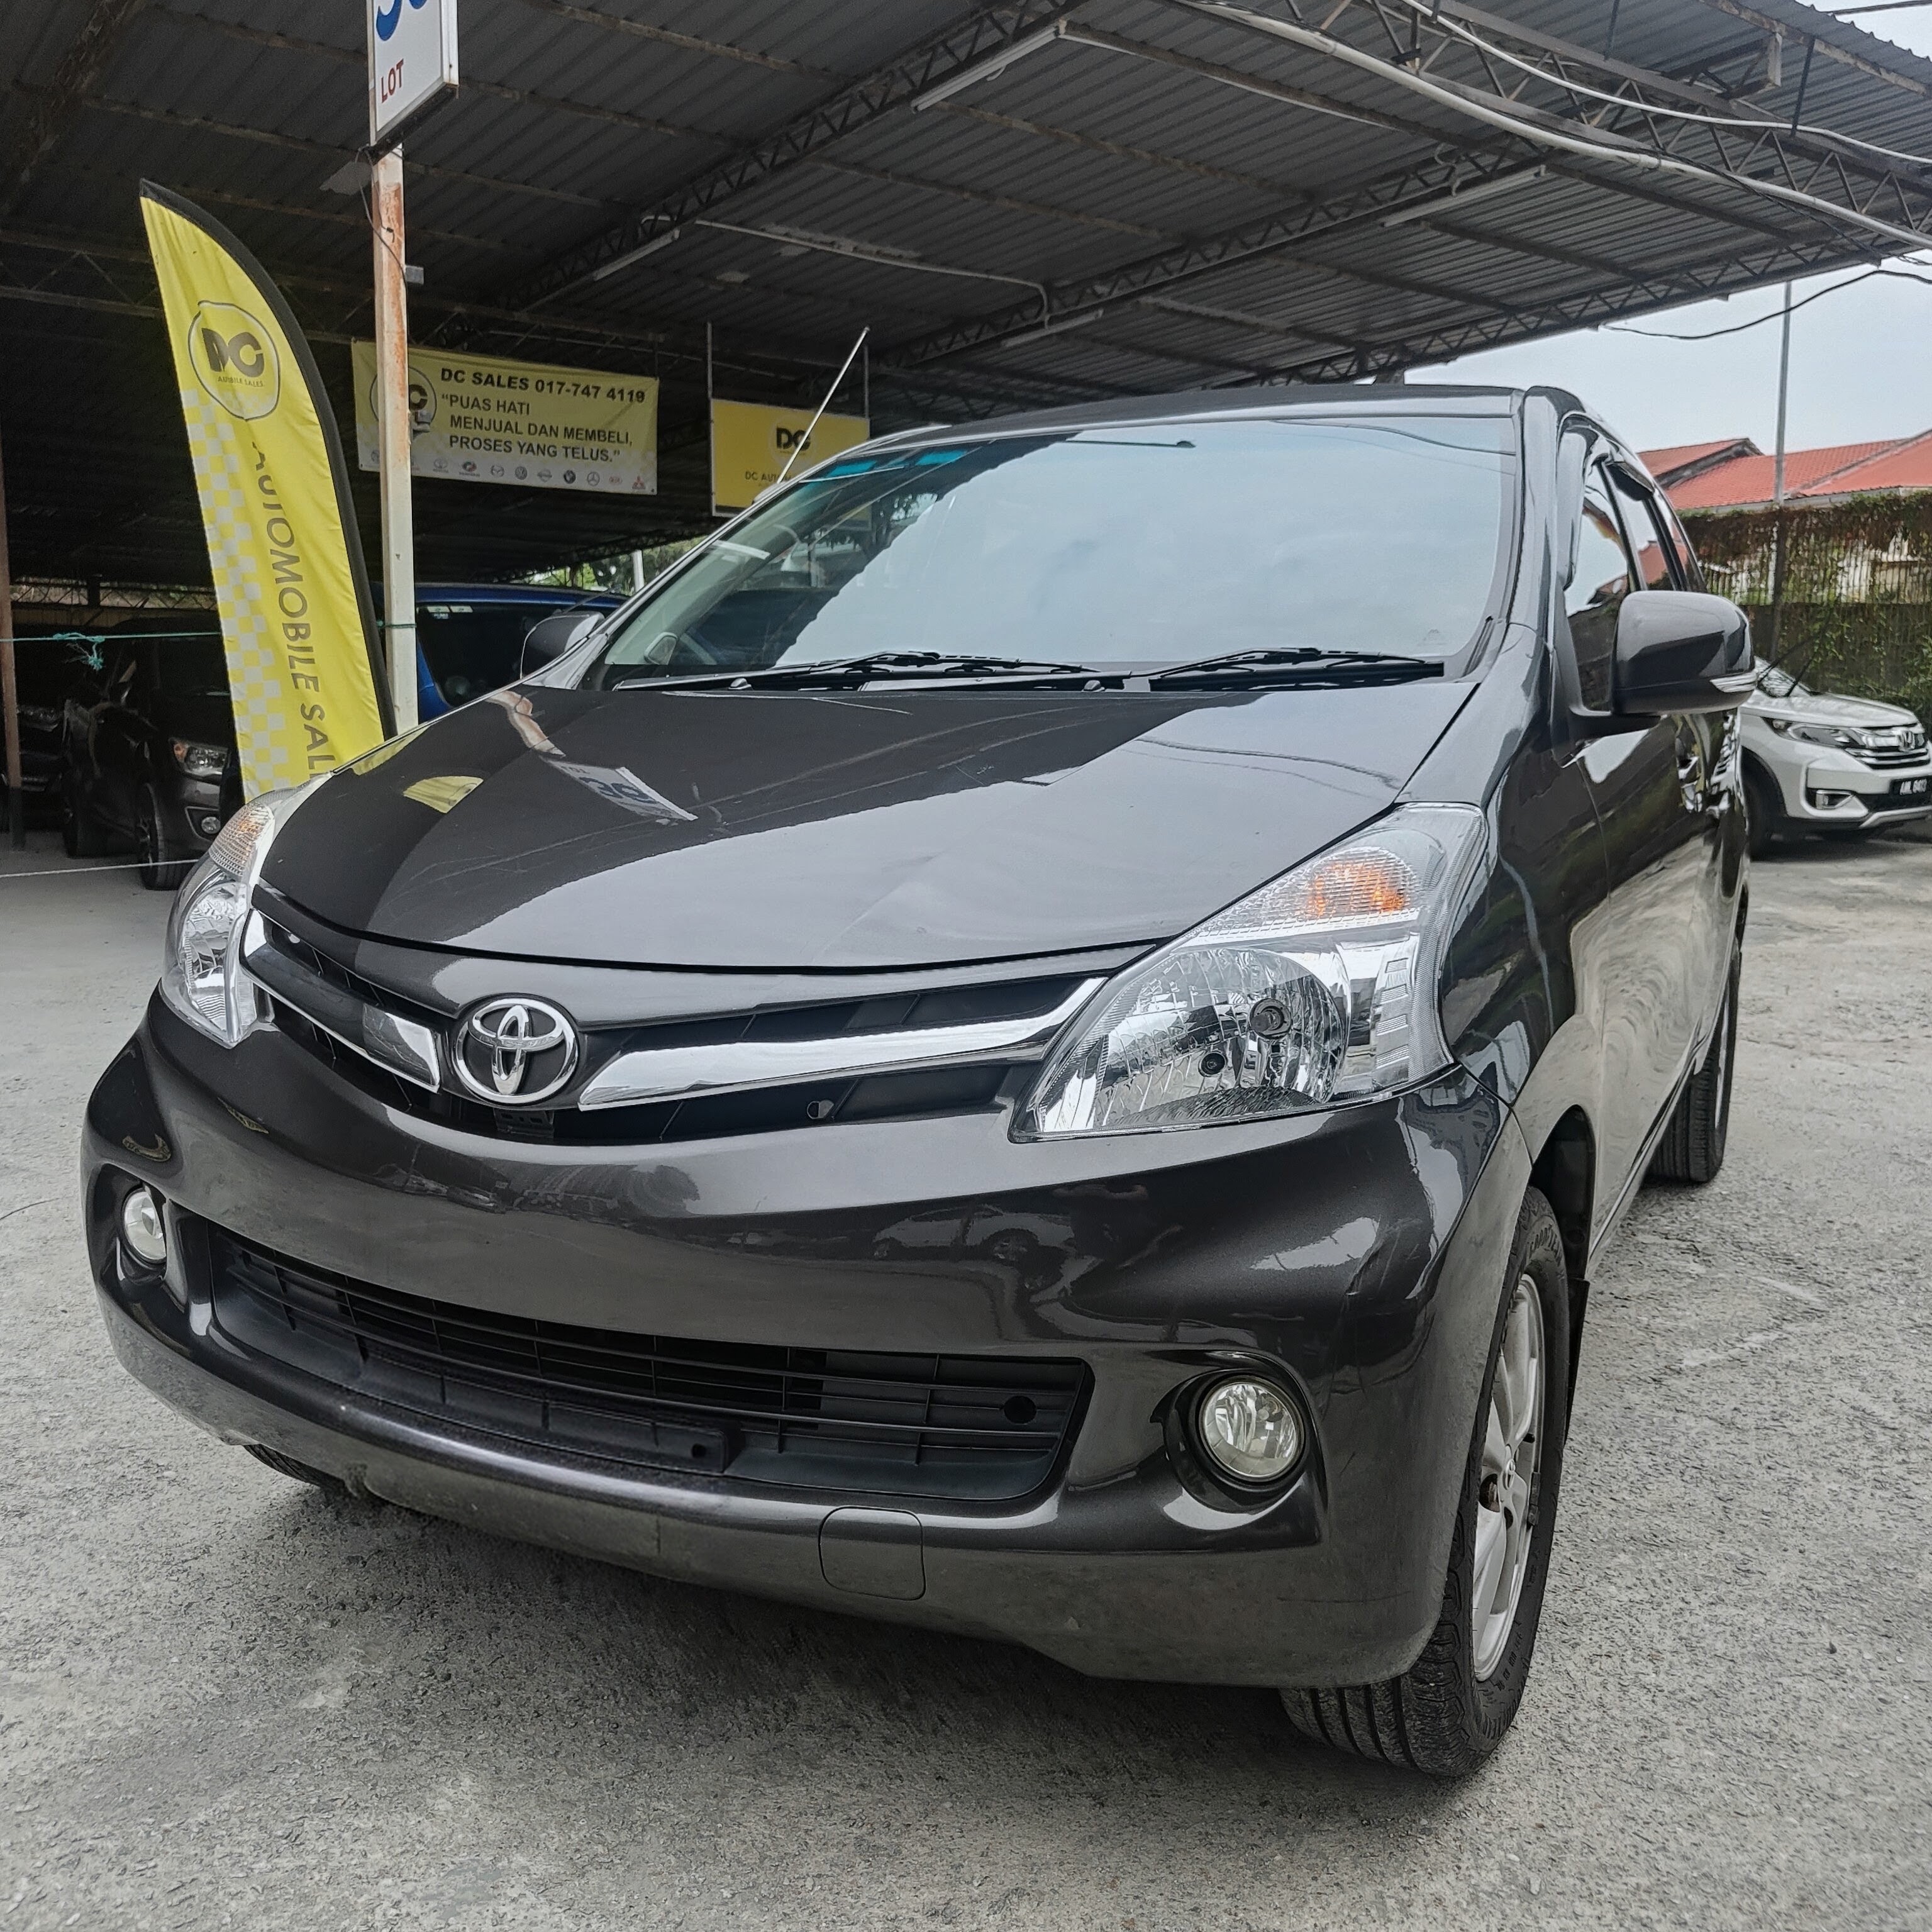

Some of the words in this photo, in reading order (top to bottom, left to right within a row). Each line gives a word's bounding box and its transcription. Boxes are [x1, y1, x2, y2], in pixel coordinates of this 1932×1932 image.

[381, 58, 404, 103] LOT
[441, 367, 465, 384] DC
[472, 372, 530, 391] SALES
[535, 379, 601, 399] 017-747
[606, 387, 645, 403] 4119
[441, 393, 491, 411] "PUAS
[496, 399, 530, 415] HATI
[450, 414, 523, 435] MENJUAL
[528, 423, 558, 438] DAN
[564, 426, 633, 447] MEMBELI,
[450, 435, 513, 453] PROSES
[517, 440, 557, 457] YANG
[745, 471, 758, 480] DC
